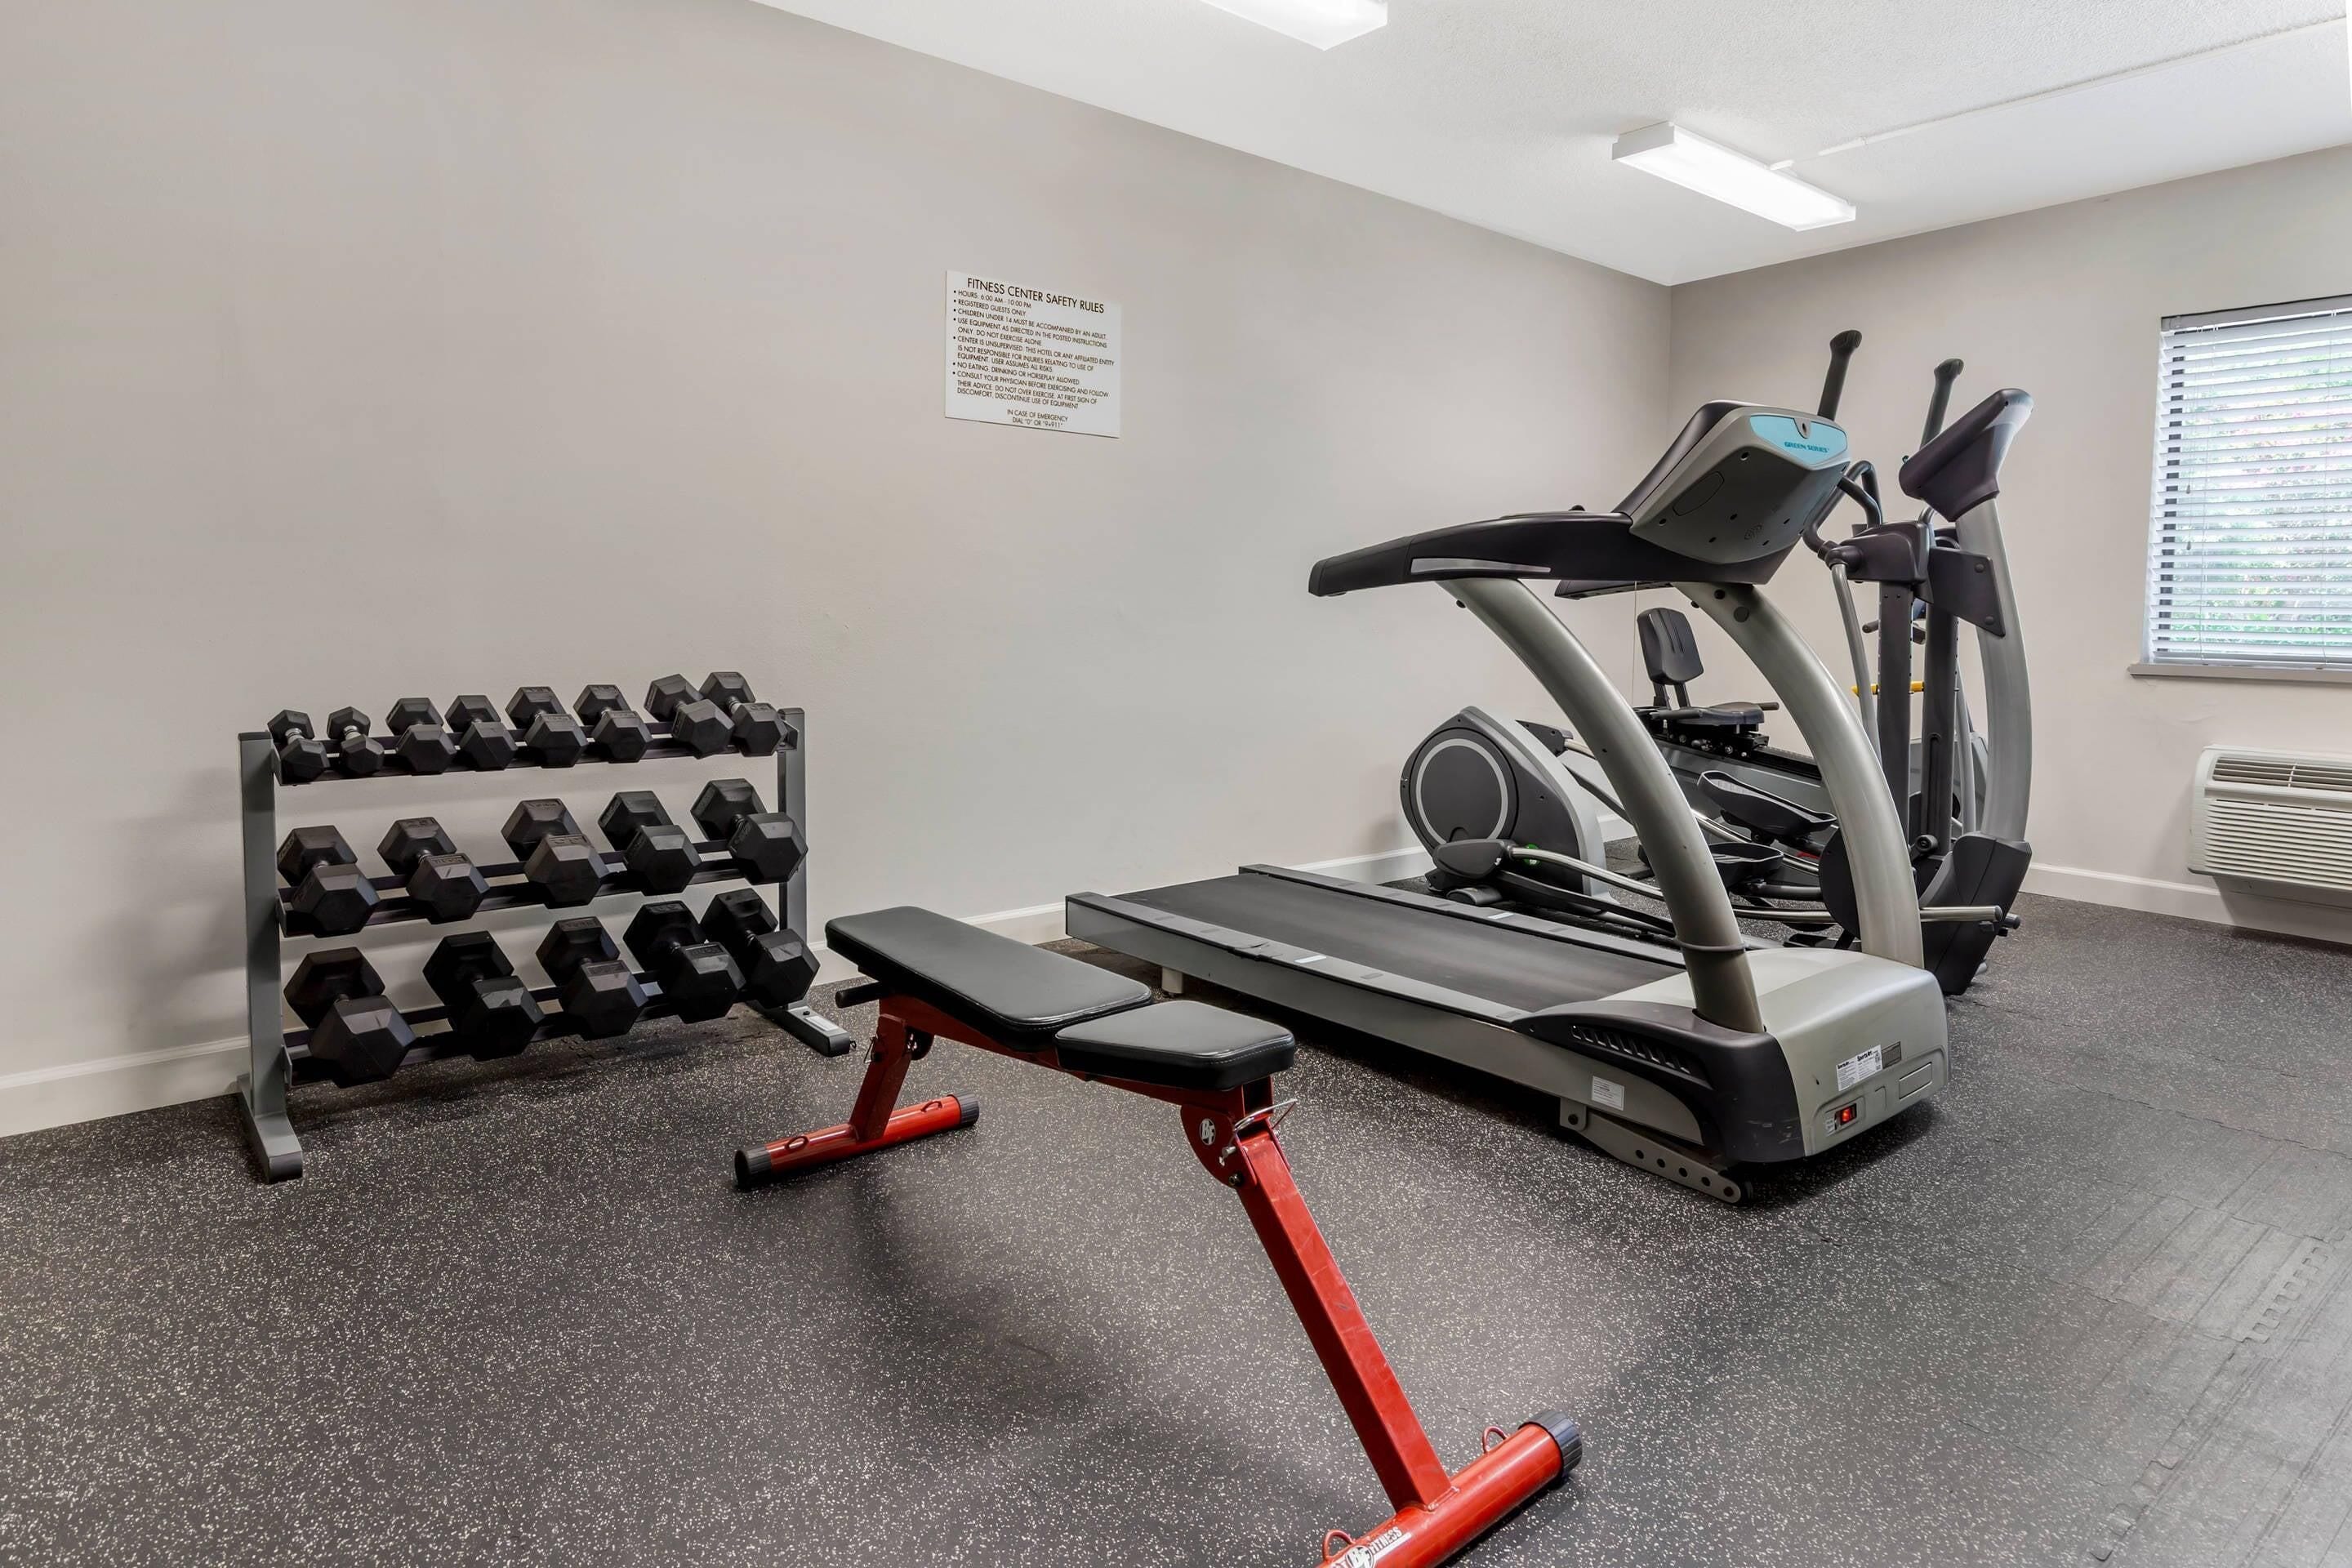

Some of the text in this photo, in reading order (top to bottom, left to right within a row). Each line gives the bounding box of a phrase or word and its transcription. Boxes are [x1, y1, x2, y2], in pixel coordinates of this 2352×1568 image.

[967, 278, 1104, 314] FITNESS CENTER SAFETY RULES
[958, 299, 989, 310] REGISTERED
[991, 305, 1009, 314] GUESTS
[958, 308, 984, 318] CHILDREN
[986, 313, 1003, 321] UNDER
[1036, 322, 1074, 334] ACCOMPANIED
[969, 319, 1000, 330] EQUIPMENT
[1010, 326, 1033, 336] DIRECTED
[1053, 333, 1071, 342] POSTED
[1072, 337, 1107, 348] INSTRUCTIONS
[1000, 333, 1022, 342] EXERCISE
[957, 336, 978, 344] CENTER
[1075, 354, 1098, 363] AFFILIATED
[964, 345, 976, 354] NOT
[978, 348, 1010, 359] RESPONSIBLE
[1023, 355, 1043, 363] INJURIES
[1045, 359, 1067, 367] RELATING
[1005, 359, 1029, 368] ASSUMES
[991, 367, 1017, 376] DRINKING
[1027, 372, 1054, 381] HORSEPLAY
[957, 371, 982, 380] CONSULT
[1000, 376, 1027, 385] PHYSICIAN
[1028, 381, 1046, 389] BEFORE
[1047, 384, 1076, 393] EXERCISING
[1089, 390, 1109, 398] FOLLOW
[957, 380, 971, 388] THEIR
[1018, 388, 1031, 396] OVER
[995, 392, 1030, 403] DISCONTINUE
[1037, 412, 1067, 421] EMERGENCY
